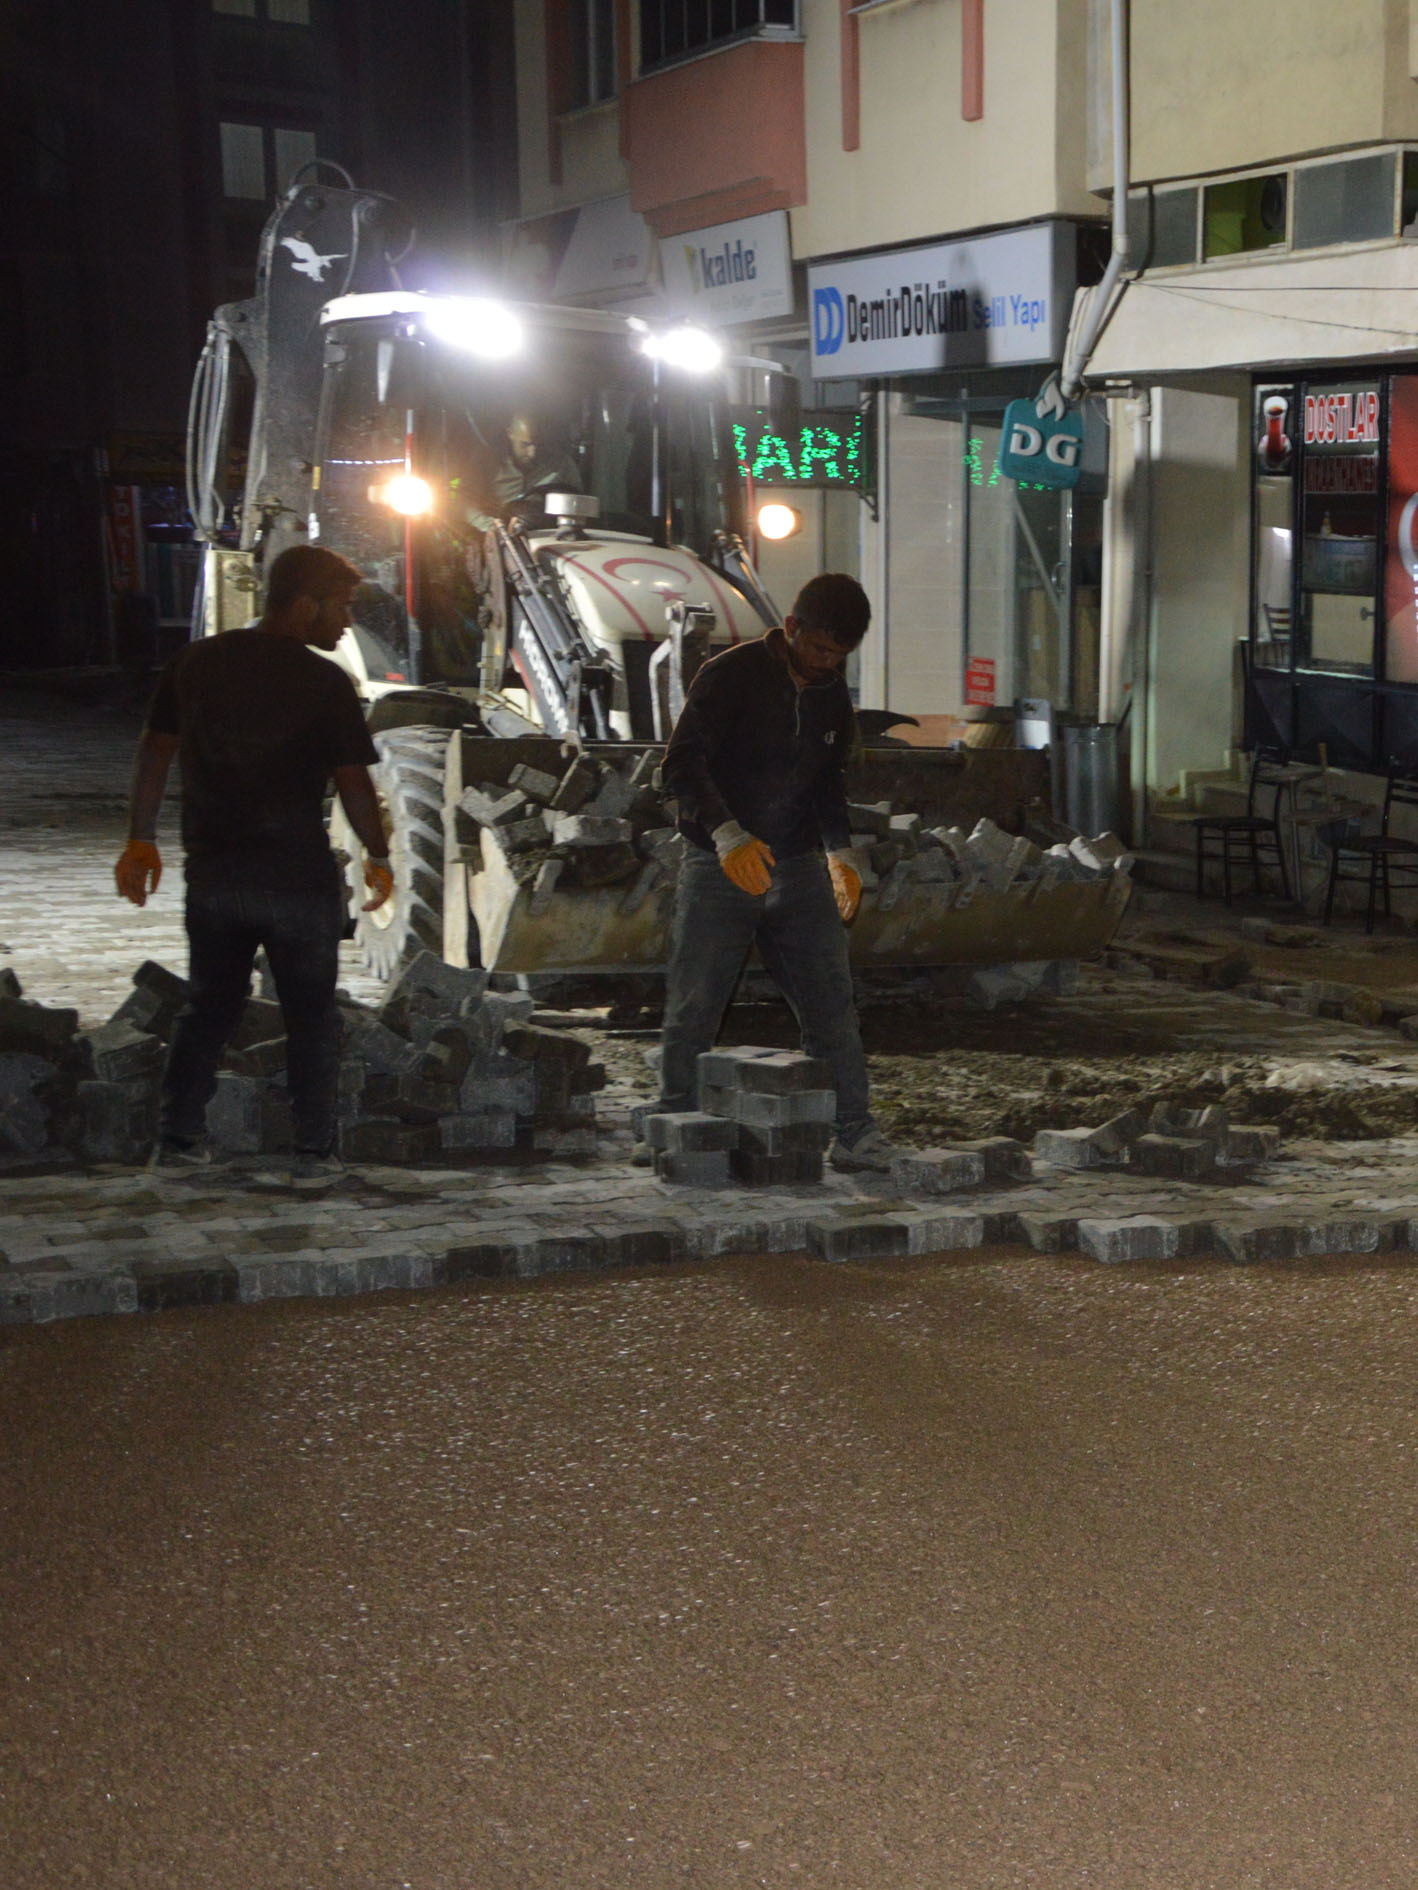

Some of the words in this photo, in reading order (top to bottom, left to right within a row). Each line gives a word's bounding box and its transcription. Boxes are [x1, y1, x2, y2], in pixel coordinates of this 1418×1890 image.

[701, 239, 757, 289] kalde
[846, 280, 968, 343] DemirDöküm
[1010, 293, 1046, 332] Yapı
[1304, 391, 1380, 444] DOSTLAR
[1009, 422, 1082, 467] DG
